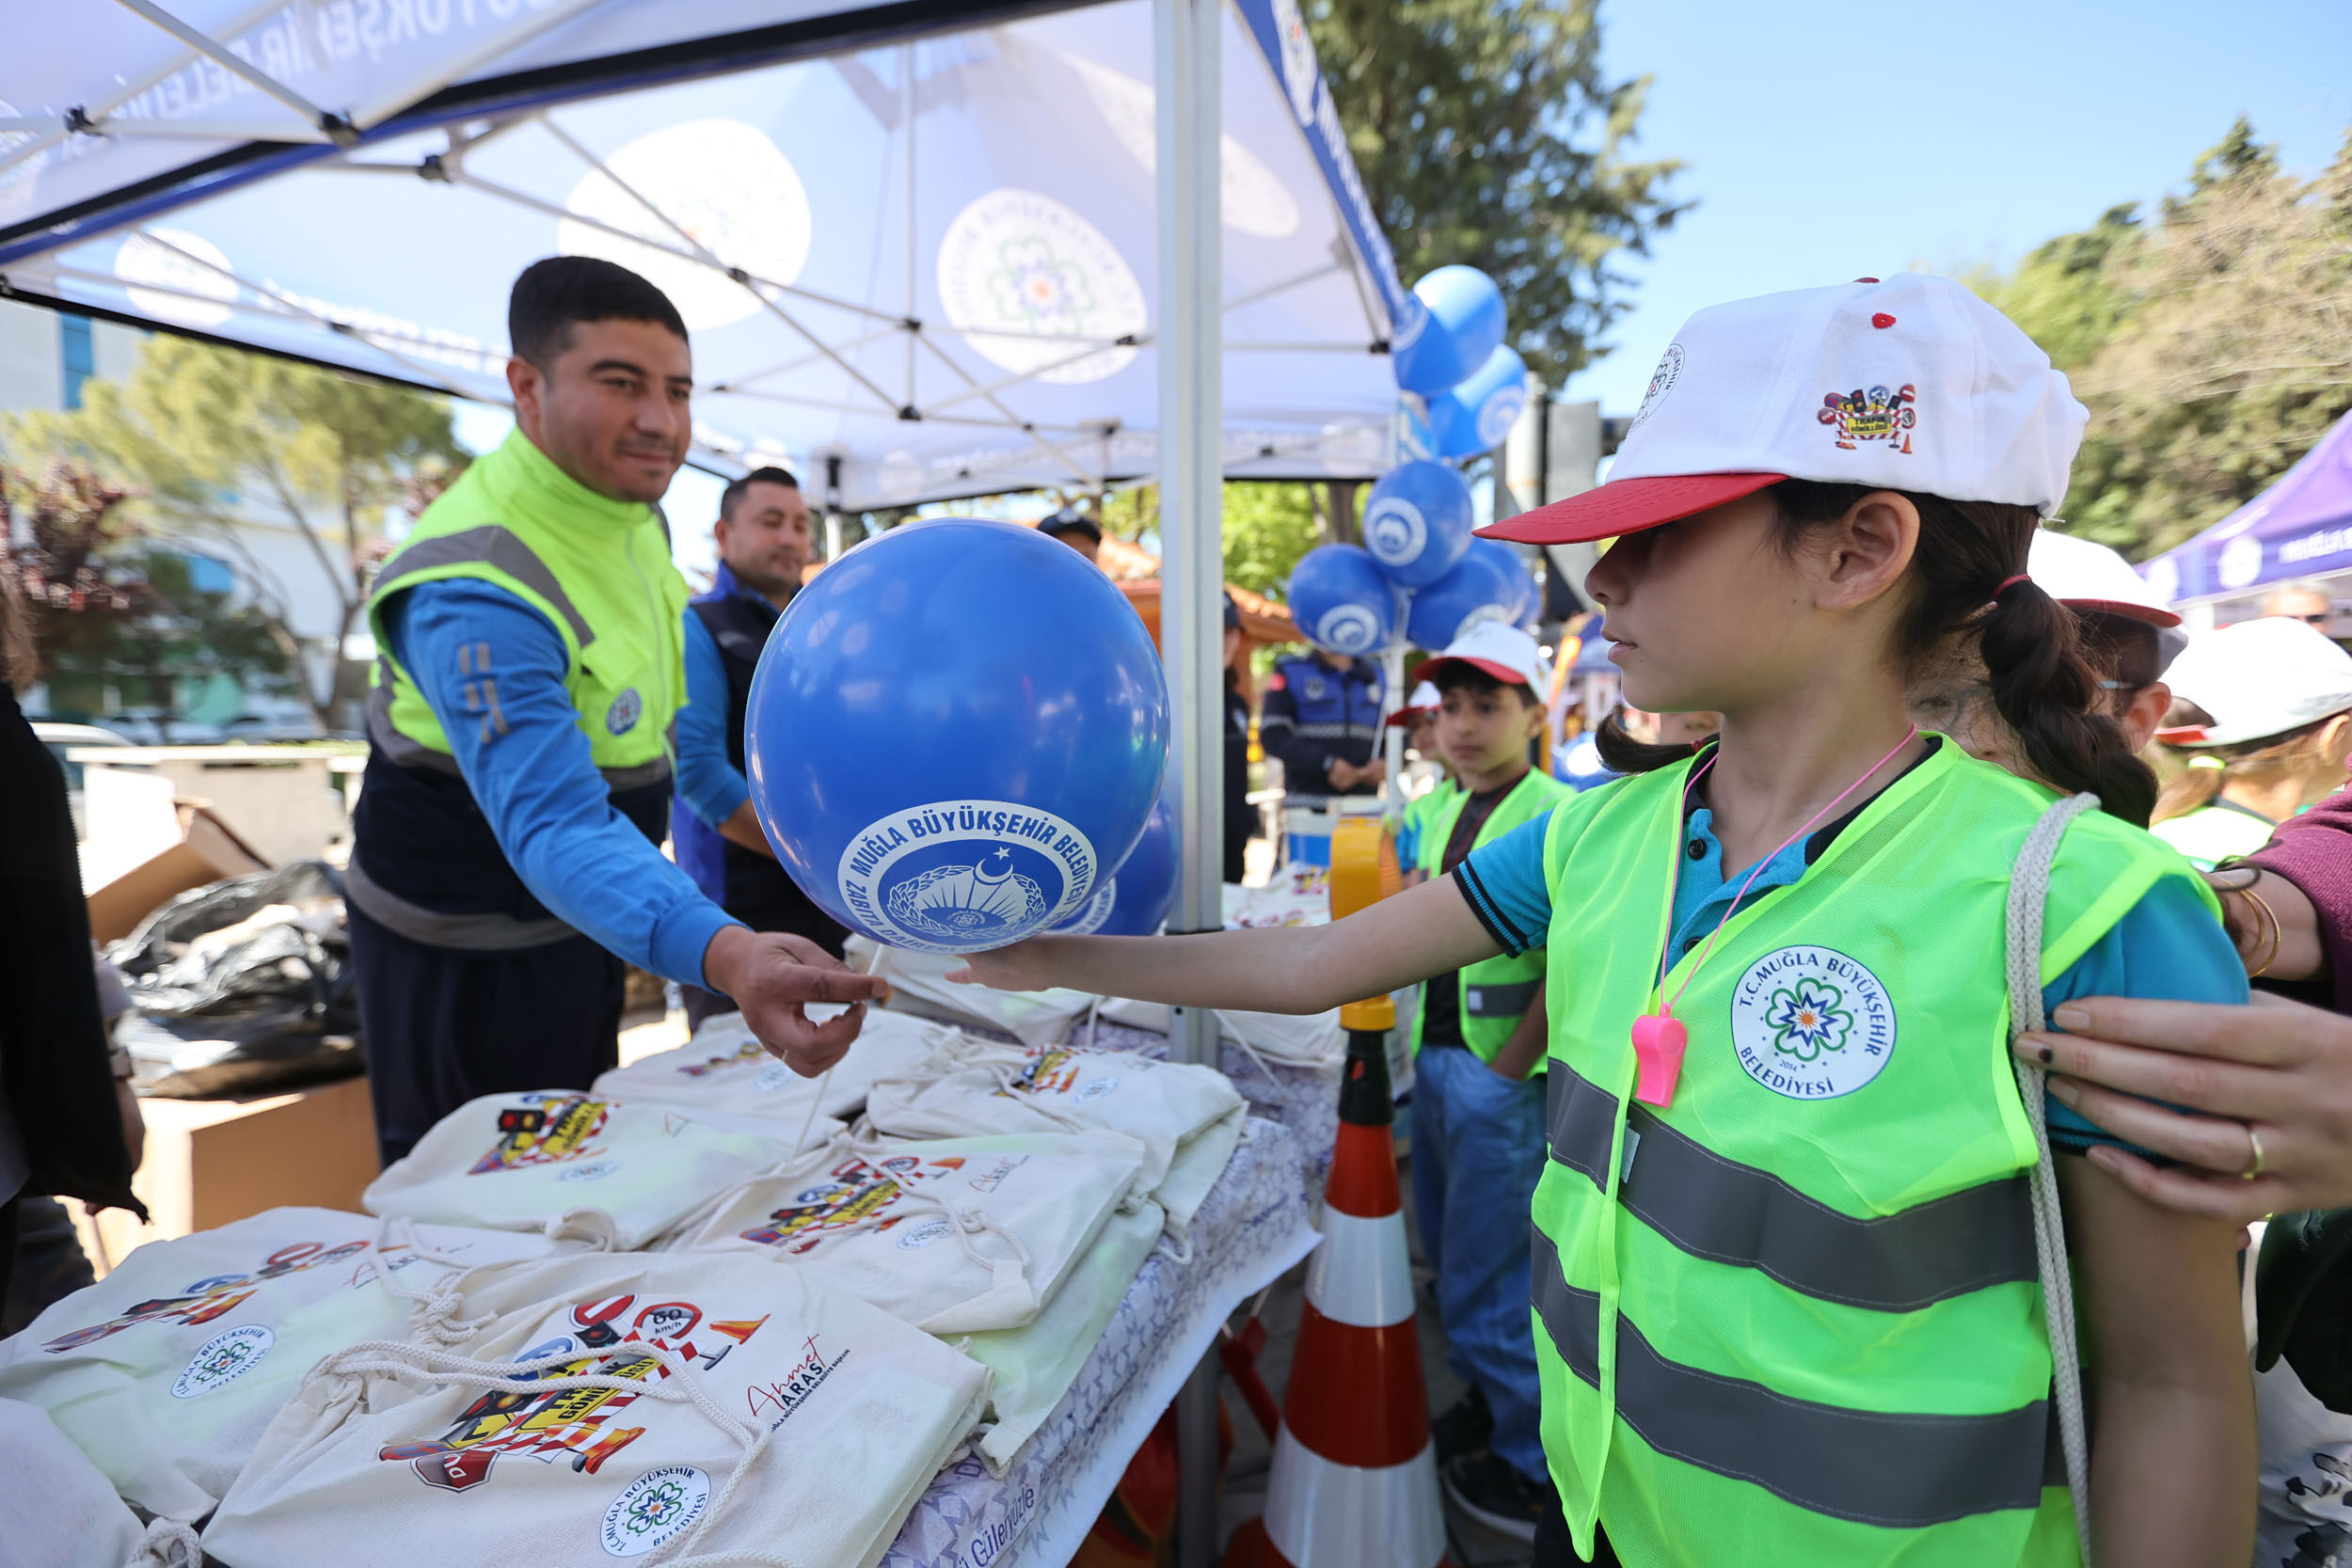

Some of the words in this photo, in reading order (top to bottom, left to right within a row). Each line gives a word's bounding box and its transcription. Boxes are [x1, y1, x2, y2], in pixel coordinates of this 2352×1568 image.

[850, 826, 909, 878] MUĞLA
[907, 805, 1058, 847] BÜYÜKŞEHİR
[1052, 833, 1097, 905] BELEDİYESİ
[1826, 958, 1888, 1056] BÜYÜKŞEHİR
[1740, 1046, 1835, 1096] BELEDİYESİ
[781, 1362, 823, 1406] ARAS
[625, 1467, 695, 1498] BÜYÜKŞEHİR
